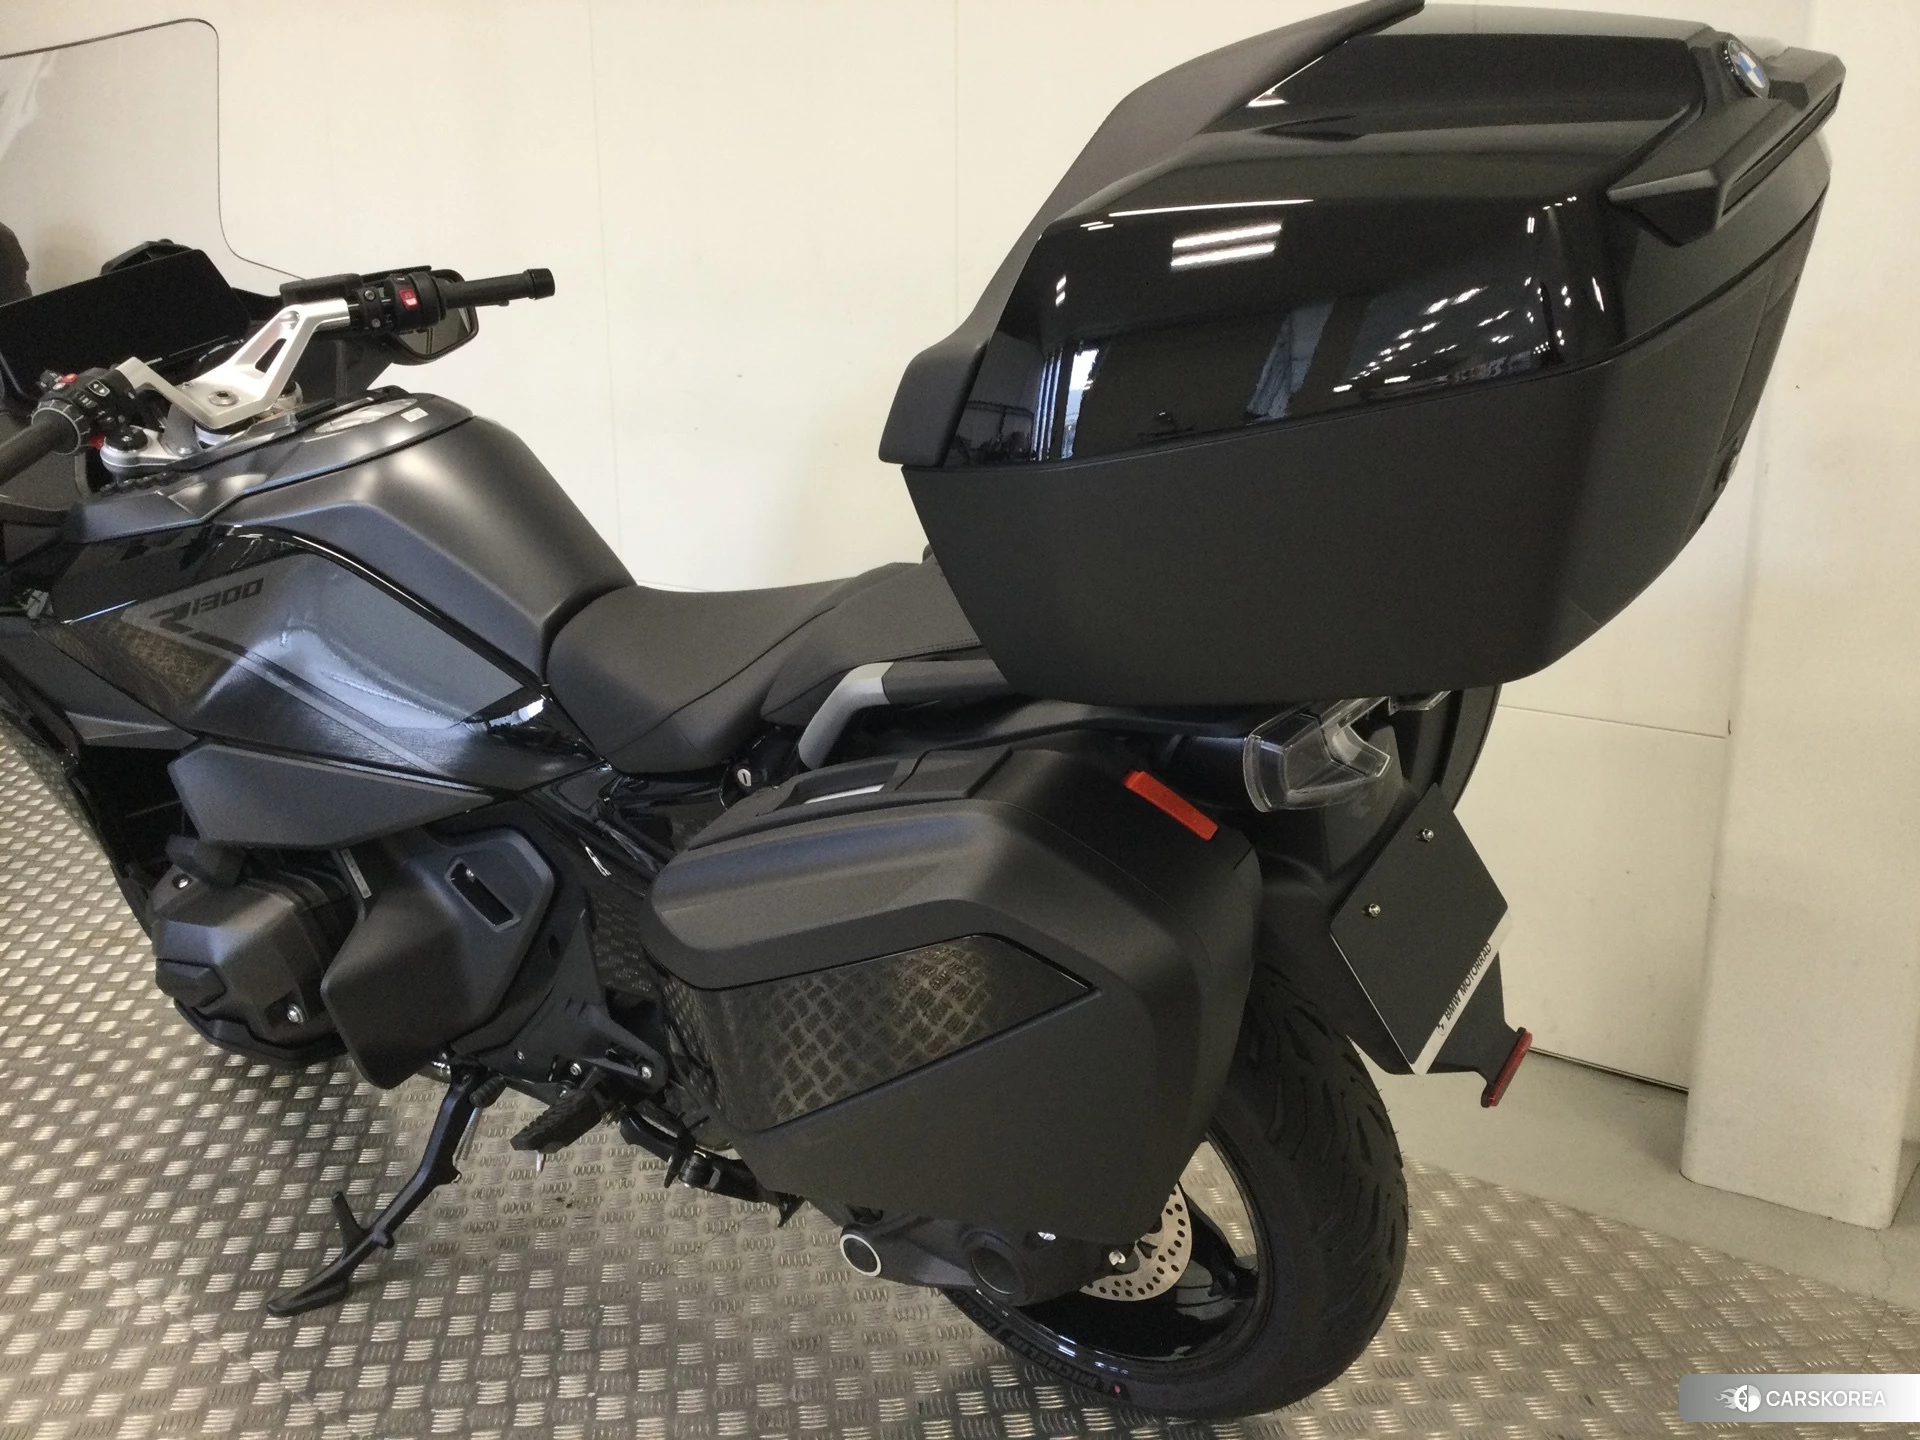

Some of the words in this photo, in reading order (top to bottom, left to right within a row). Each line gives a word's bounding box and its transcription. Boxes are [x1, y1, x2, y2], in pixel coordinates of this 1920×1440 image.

[1444, 991, 1462, 1021] BMW
[1460, 942, 1492, 997] MOTORRAD
[1006, 1334, 1099, 1388] MICHELIN
